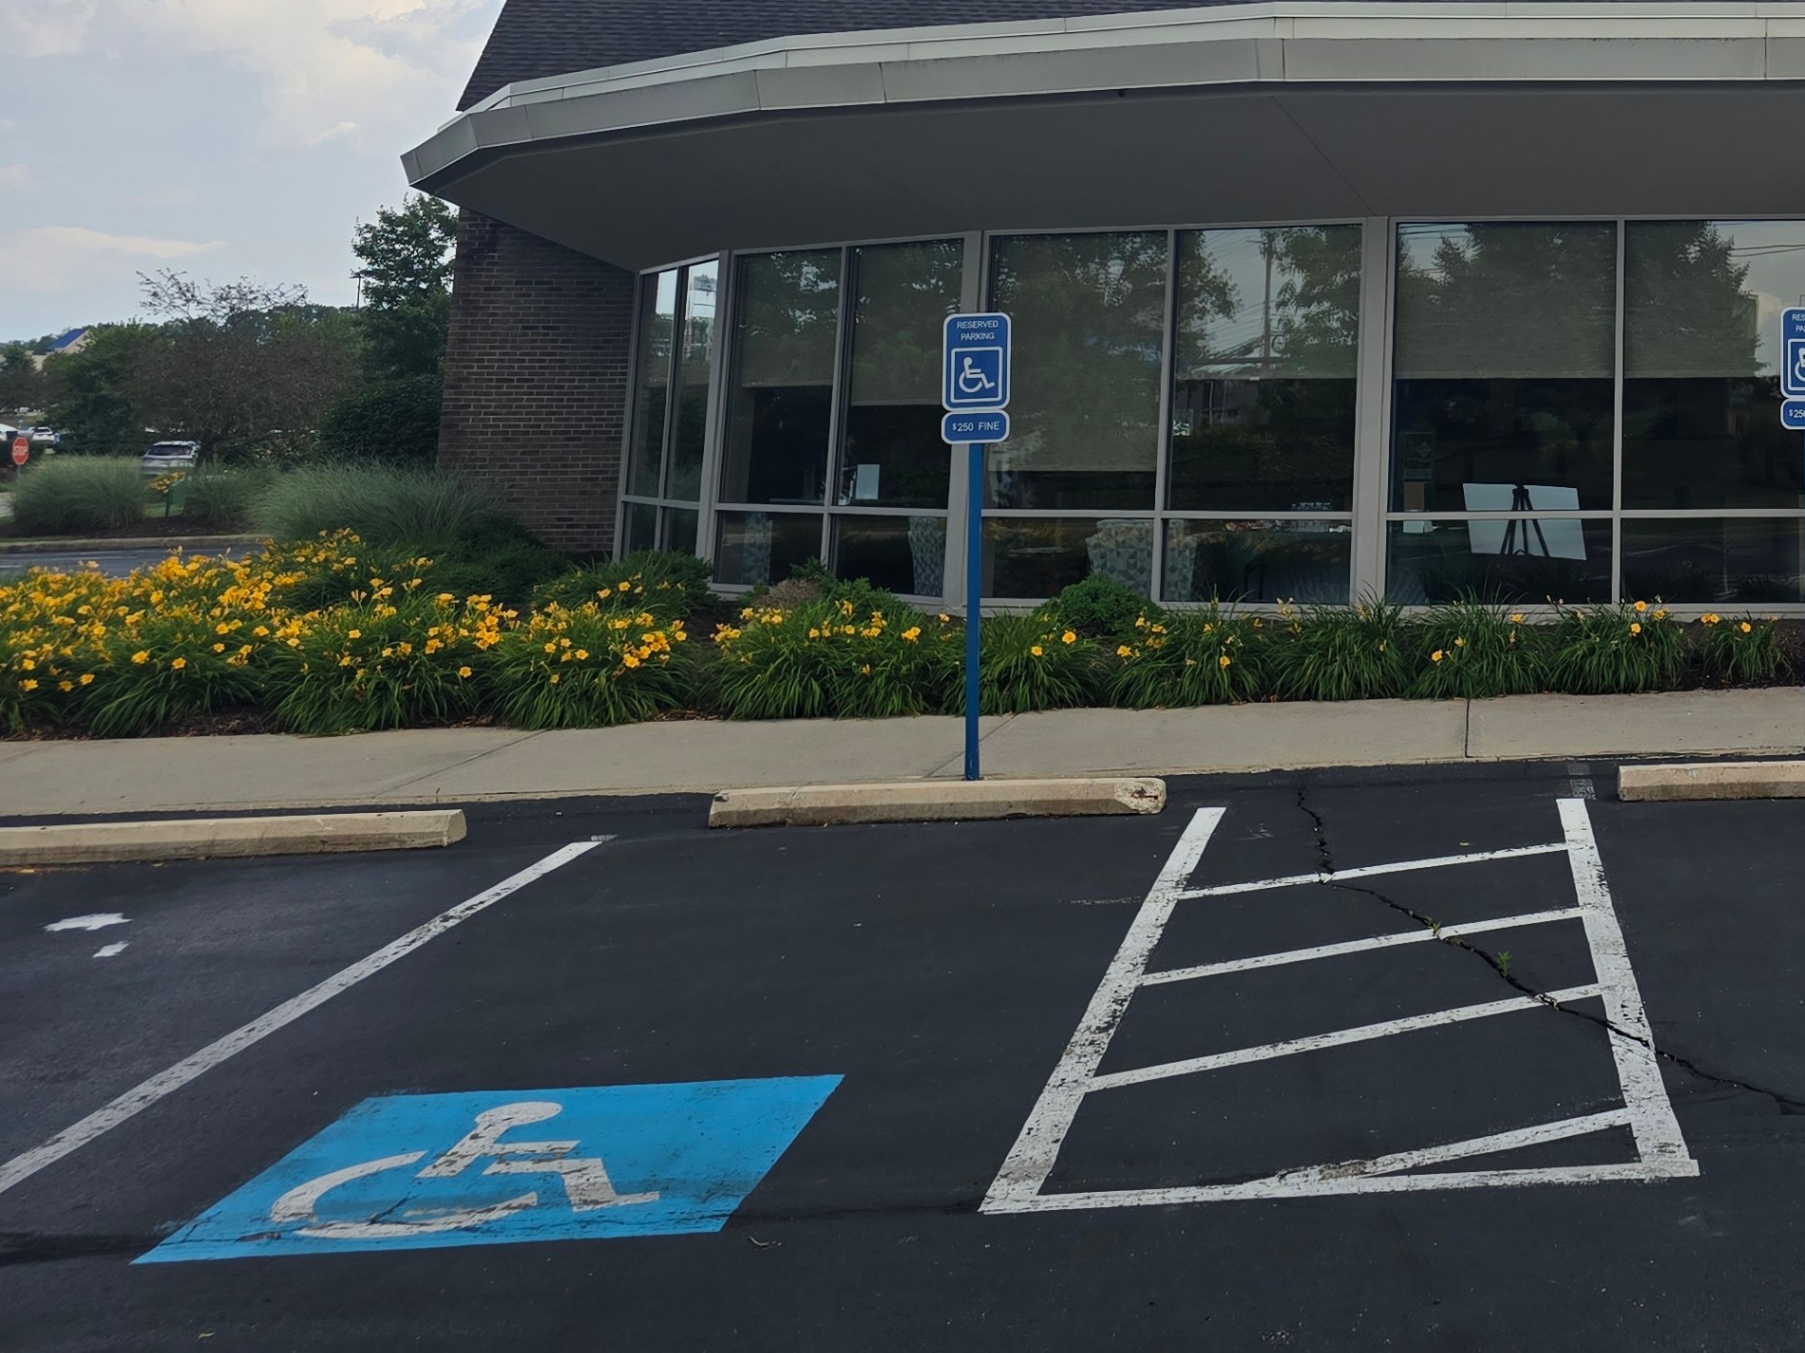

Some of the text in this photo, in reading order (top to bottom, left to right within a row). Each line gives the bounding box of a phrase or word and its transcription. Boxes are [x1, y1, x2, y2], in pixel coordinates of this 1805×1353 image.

[956, 320, 999, 329] RESERVED
[960, 332, 995, 341] PARKING
[952, 421, 1000, 432] $250 FINE
